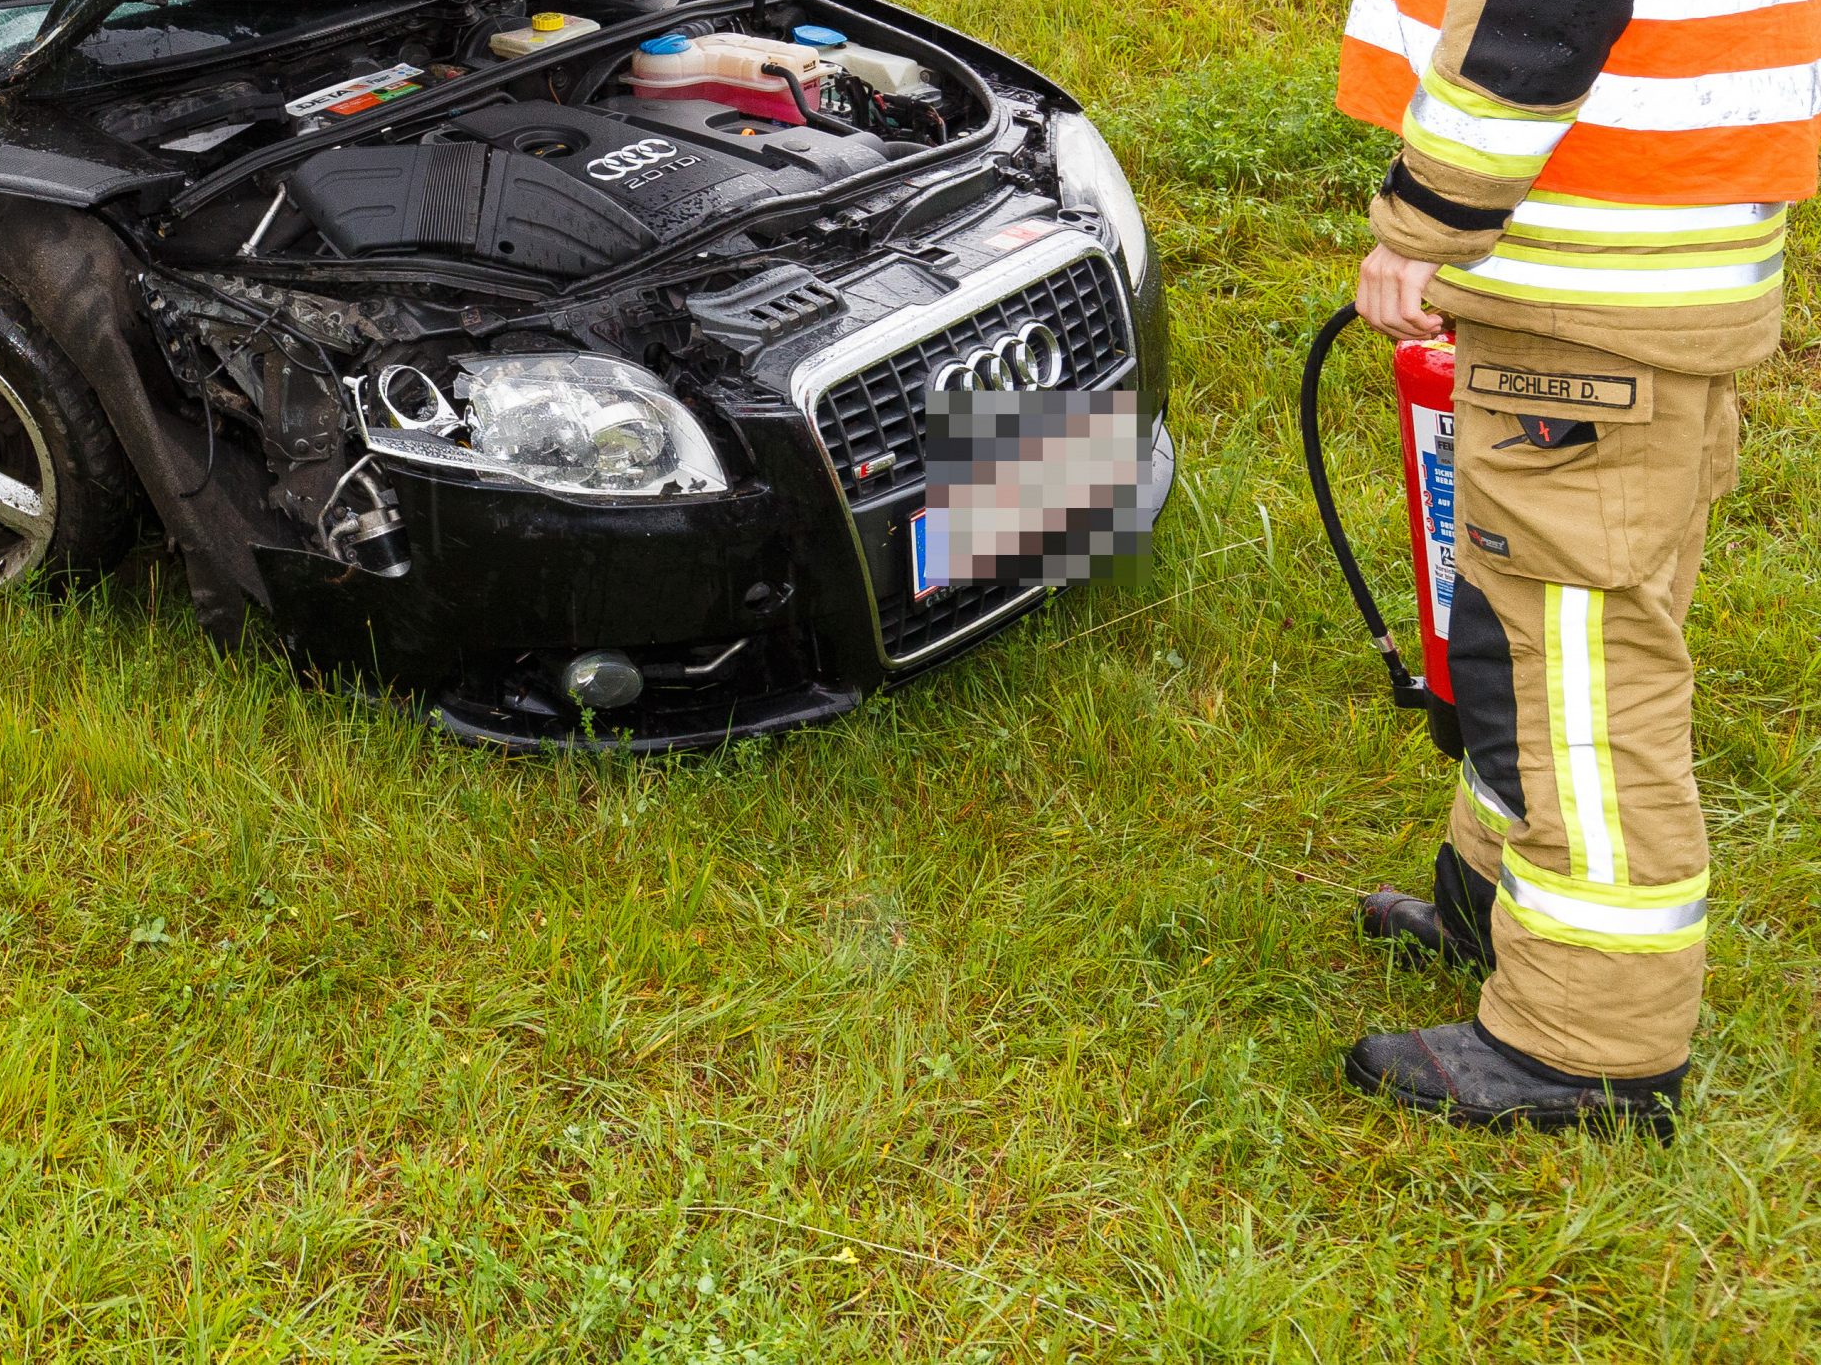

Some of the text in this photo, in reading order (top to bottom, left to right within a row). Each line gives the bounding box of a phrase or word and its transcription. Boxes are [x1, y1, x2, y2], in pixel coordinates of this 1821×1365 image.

[295, 89, 354, 111] DETA
[659, 154, 702, 171] TDI
[1498, 373, 1599, 400] PICHLER D.
[1437, 440, 1454, 452] FEU
[1434, 467, 1453, 479] SICHE
[1435, 476, 1454, 487] HERA
[1423, 490, 1434, 508] 2
[1426, 516, 1436, 534] 3
